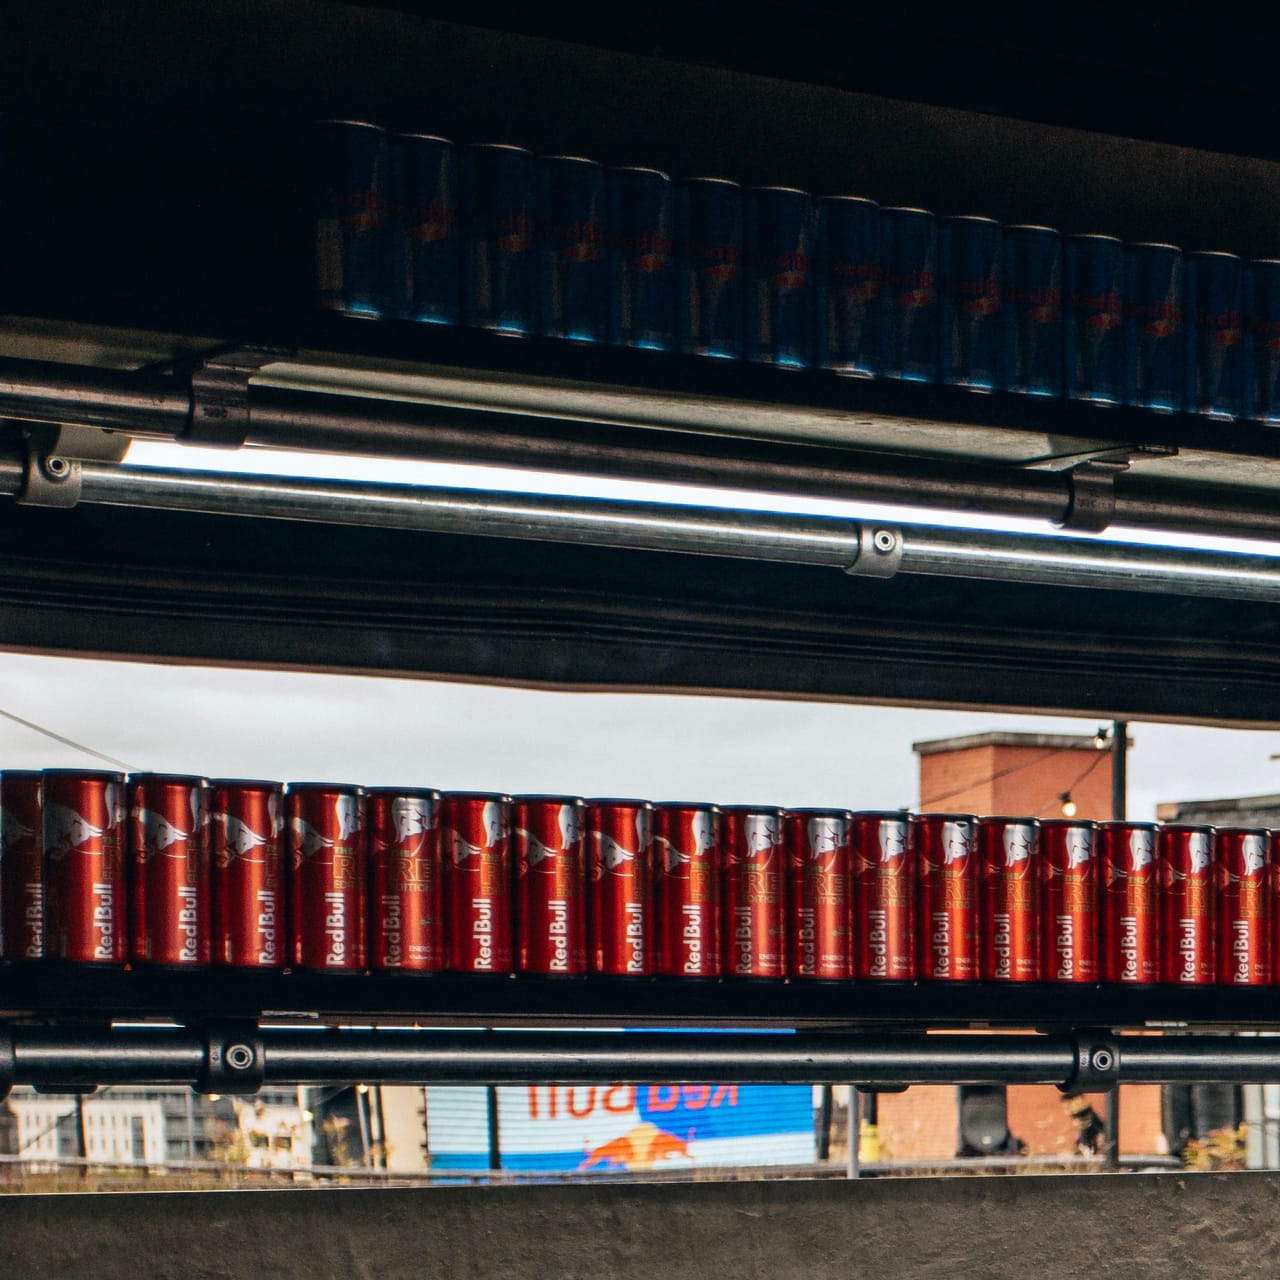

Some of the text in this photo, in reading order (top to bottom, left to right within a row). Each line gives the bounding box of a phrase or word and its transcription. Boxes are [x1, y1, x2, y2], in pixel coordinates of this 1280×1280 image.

[93, 884, 113, 959] Red Bull
[178, 886, 197, 961] Red Bull
[257, 890, 275, 964] Red Bull
[325, 893, 344, 927] Bull
[382, 896, 400, 966] Red Bull
[472, 898, 492, 970] Red Bull
[549, 901, 567, 970] Red Bull
[626, 902, 643, 972] Red Bull
[682, 905, 701, 973] Red Bull
[736, 906, 752, 974] Red Bull
[799, 908, 815, 975] Red Bull
[870, 910, 887, 977] Red Bull
[325, 930, 344, 965] Red
[933, 912, 949, 978] Red Bull
[994, 914, 1010, 978] Red Bull
[1057, 915, 1073, 979] Red Bull
[1120, 917, 1137, 980] Red Bull
[1180, 919, 1196, 982] Red Bull
[1233, 920, 1249, 983] Red Bull
